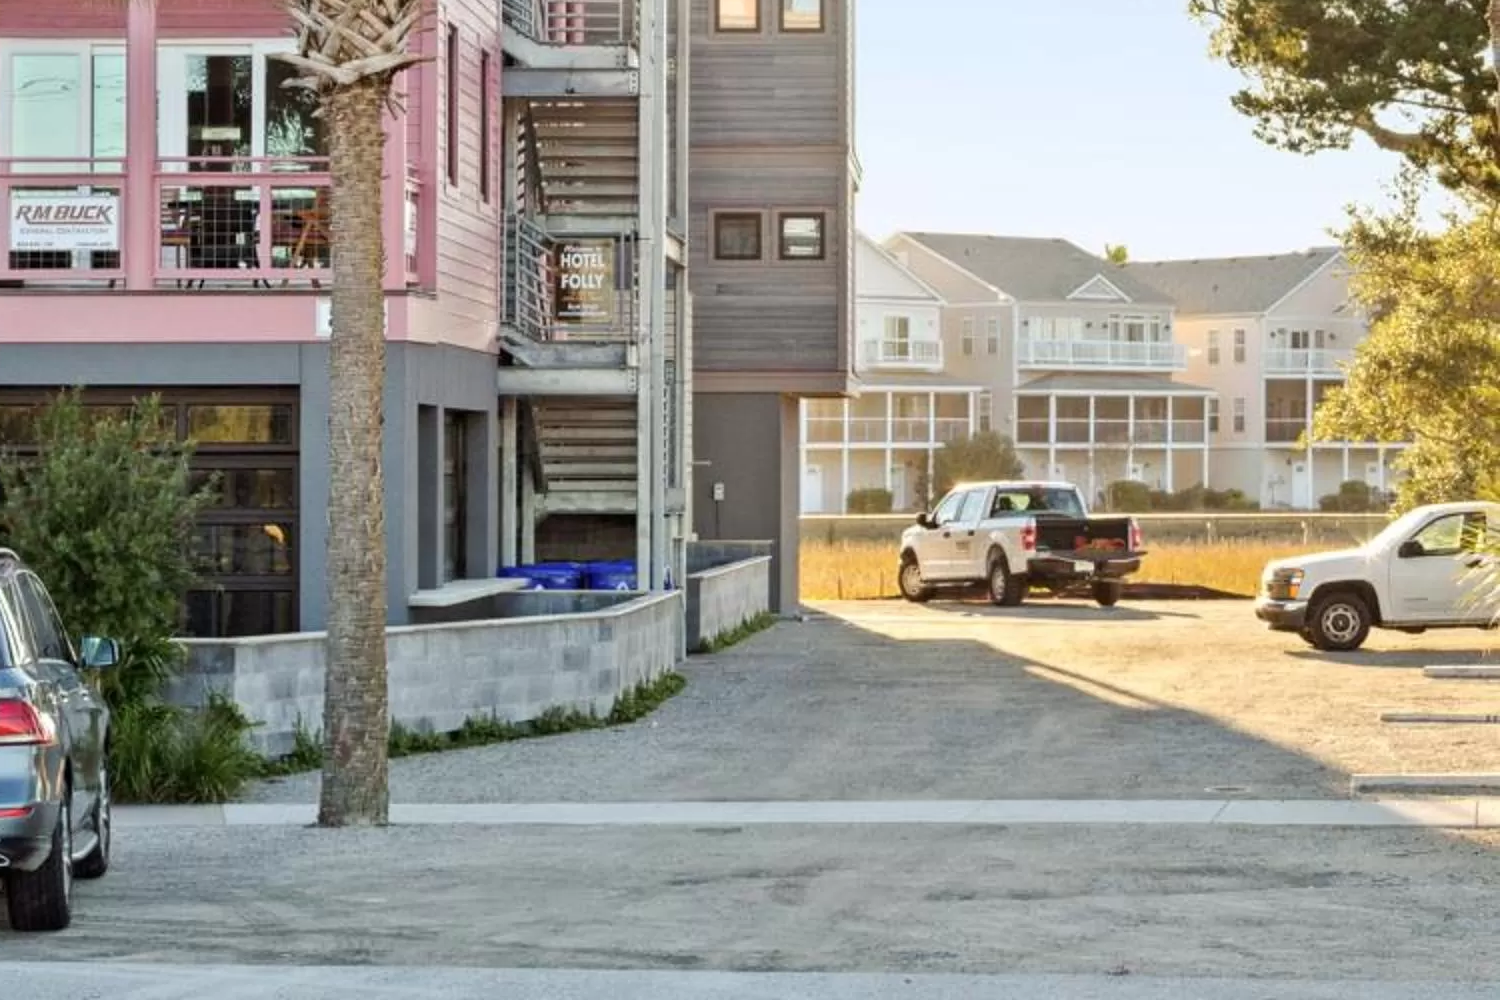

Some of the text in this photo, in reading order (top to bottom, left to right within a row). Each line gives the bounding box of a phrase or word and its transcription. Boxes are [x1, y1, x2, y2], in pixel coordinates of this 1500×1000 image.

[54, 205, 113, 225] BUCK
[561, 253, 604, 269] HOTEL
[561, 274, 604, 289] FOLLY
